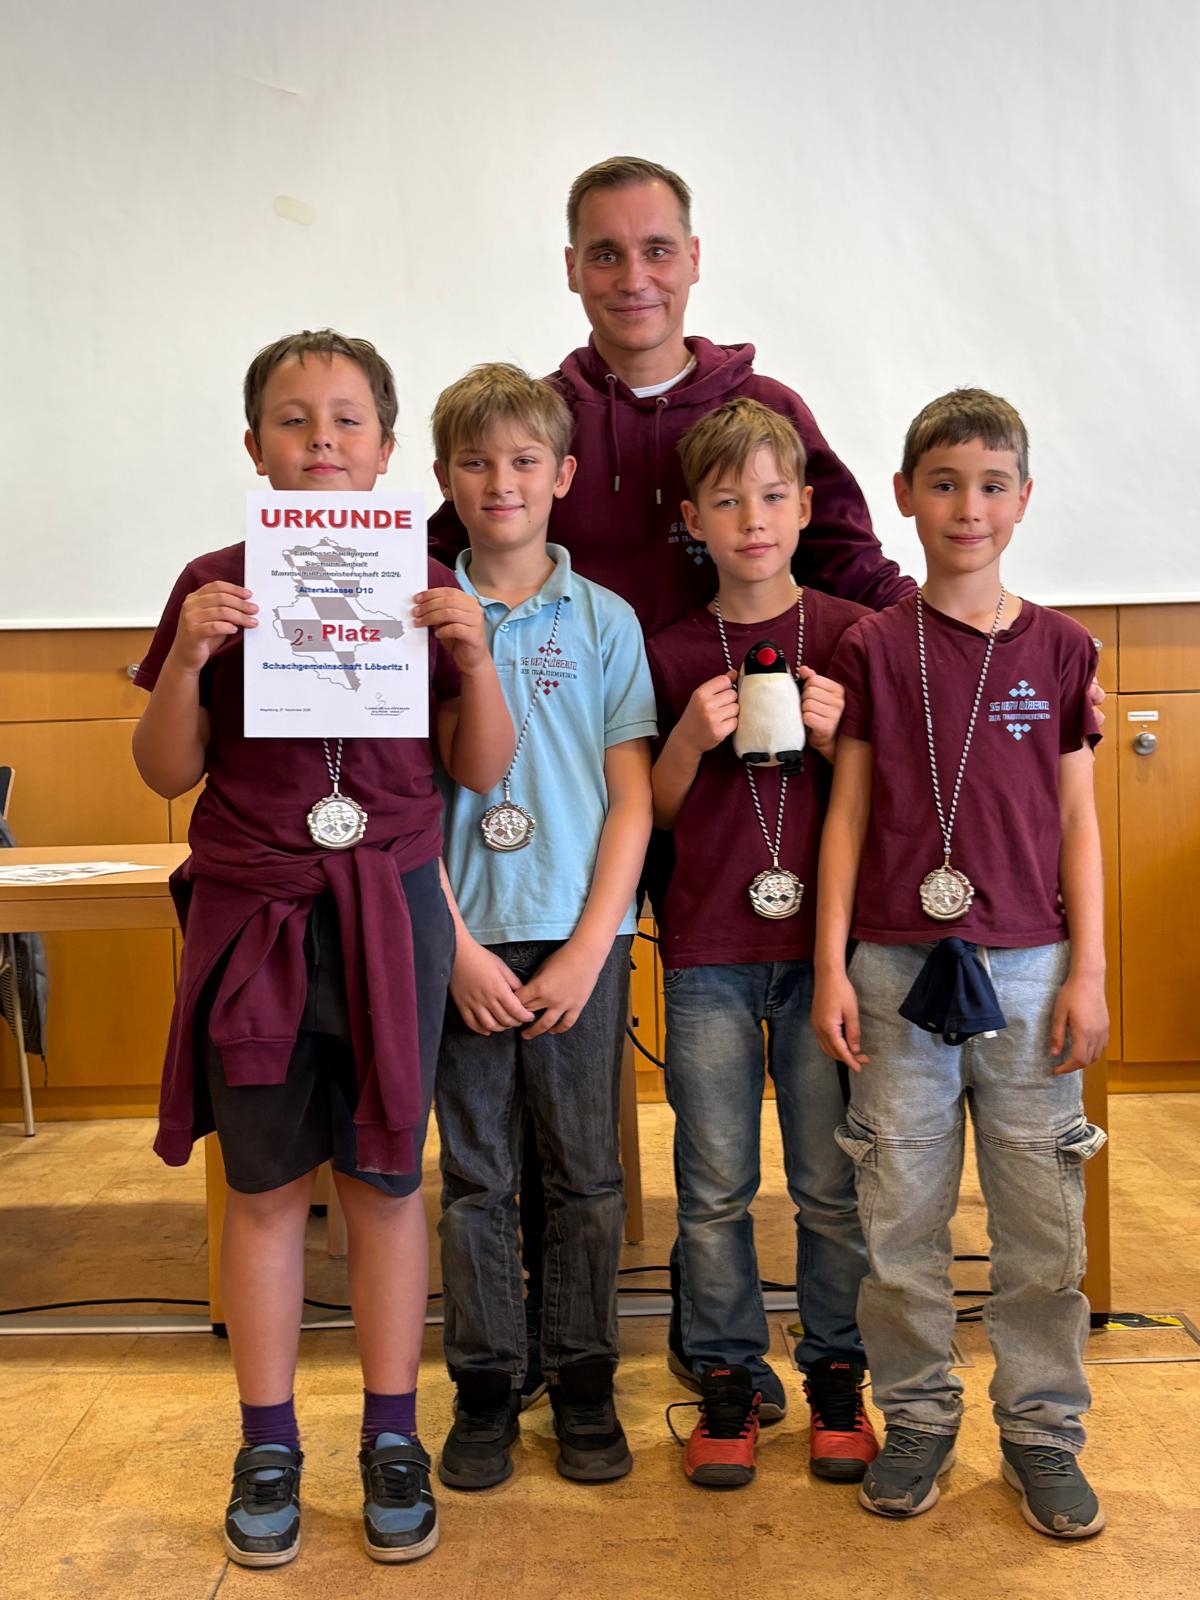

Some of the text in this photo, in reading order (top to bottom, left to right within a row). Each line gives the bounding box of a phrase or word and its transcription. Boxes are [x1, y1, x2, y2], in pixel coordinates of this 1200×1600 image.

[261, 509, 412, 529] URKUNDE
[299, 586, 353, 594] Altersklasse
[322, 624, 381, 642] Platz
[262, 662, 362, 671] Schachgemeinschaft
[365, 661, 403, 671] Löberitz
